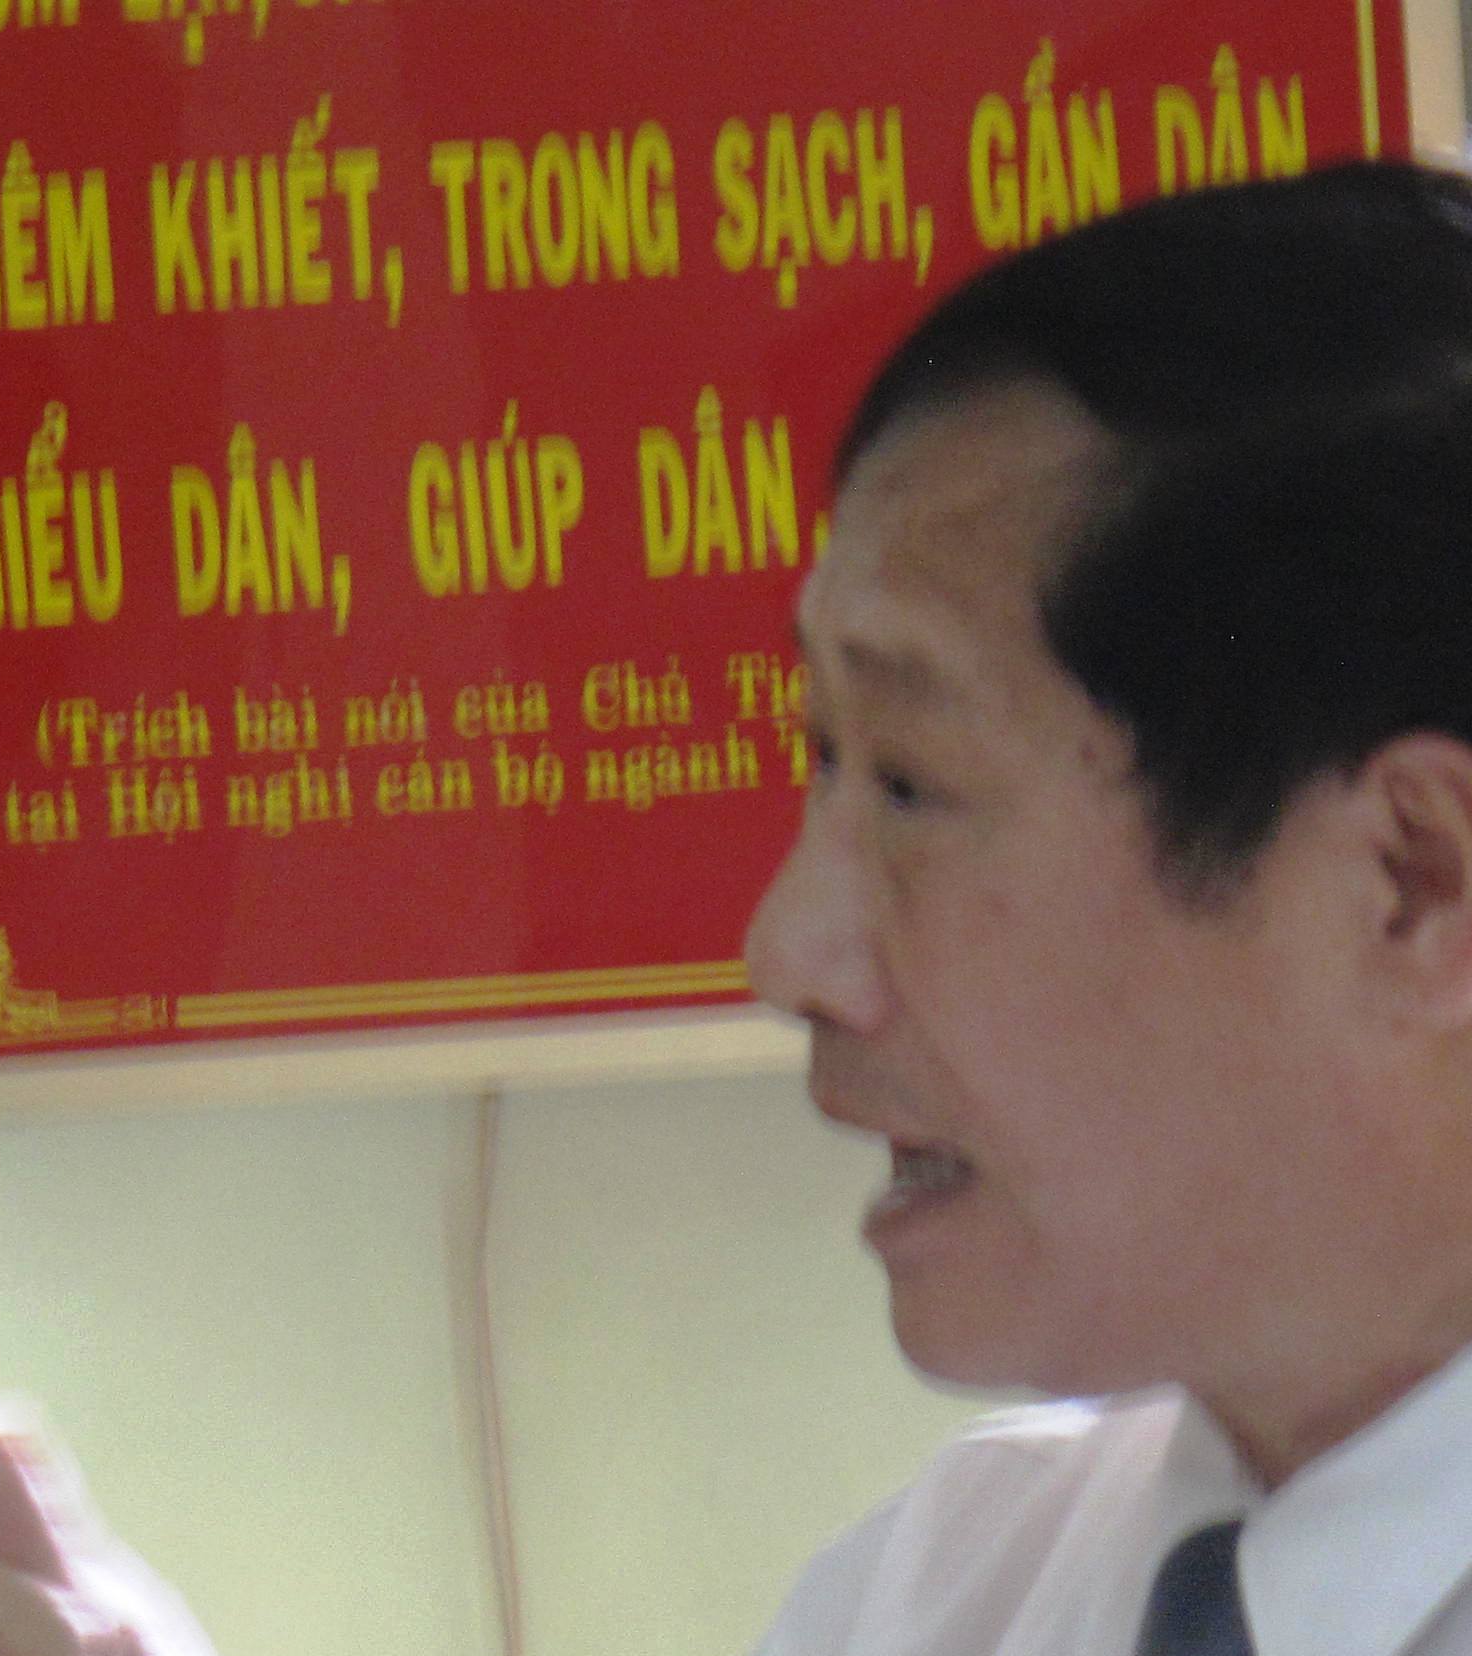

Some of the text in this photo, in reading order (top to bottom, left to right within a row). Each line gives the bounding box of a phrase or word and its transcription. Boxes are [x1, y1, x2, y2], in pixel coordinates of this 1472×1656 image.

[150, 92, 404, 328] KHIẾT,
[432, 118, 680, 296] TRONG
[714, 106, 933, 310] SẠCH,
[1155, 44, 1308, 194] DÂN
[171, 422, 350, 636] DÂN,
[408, 398, 586, 598] GIÚP
